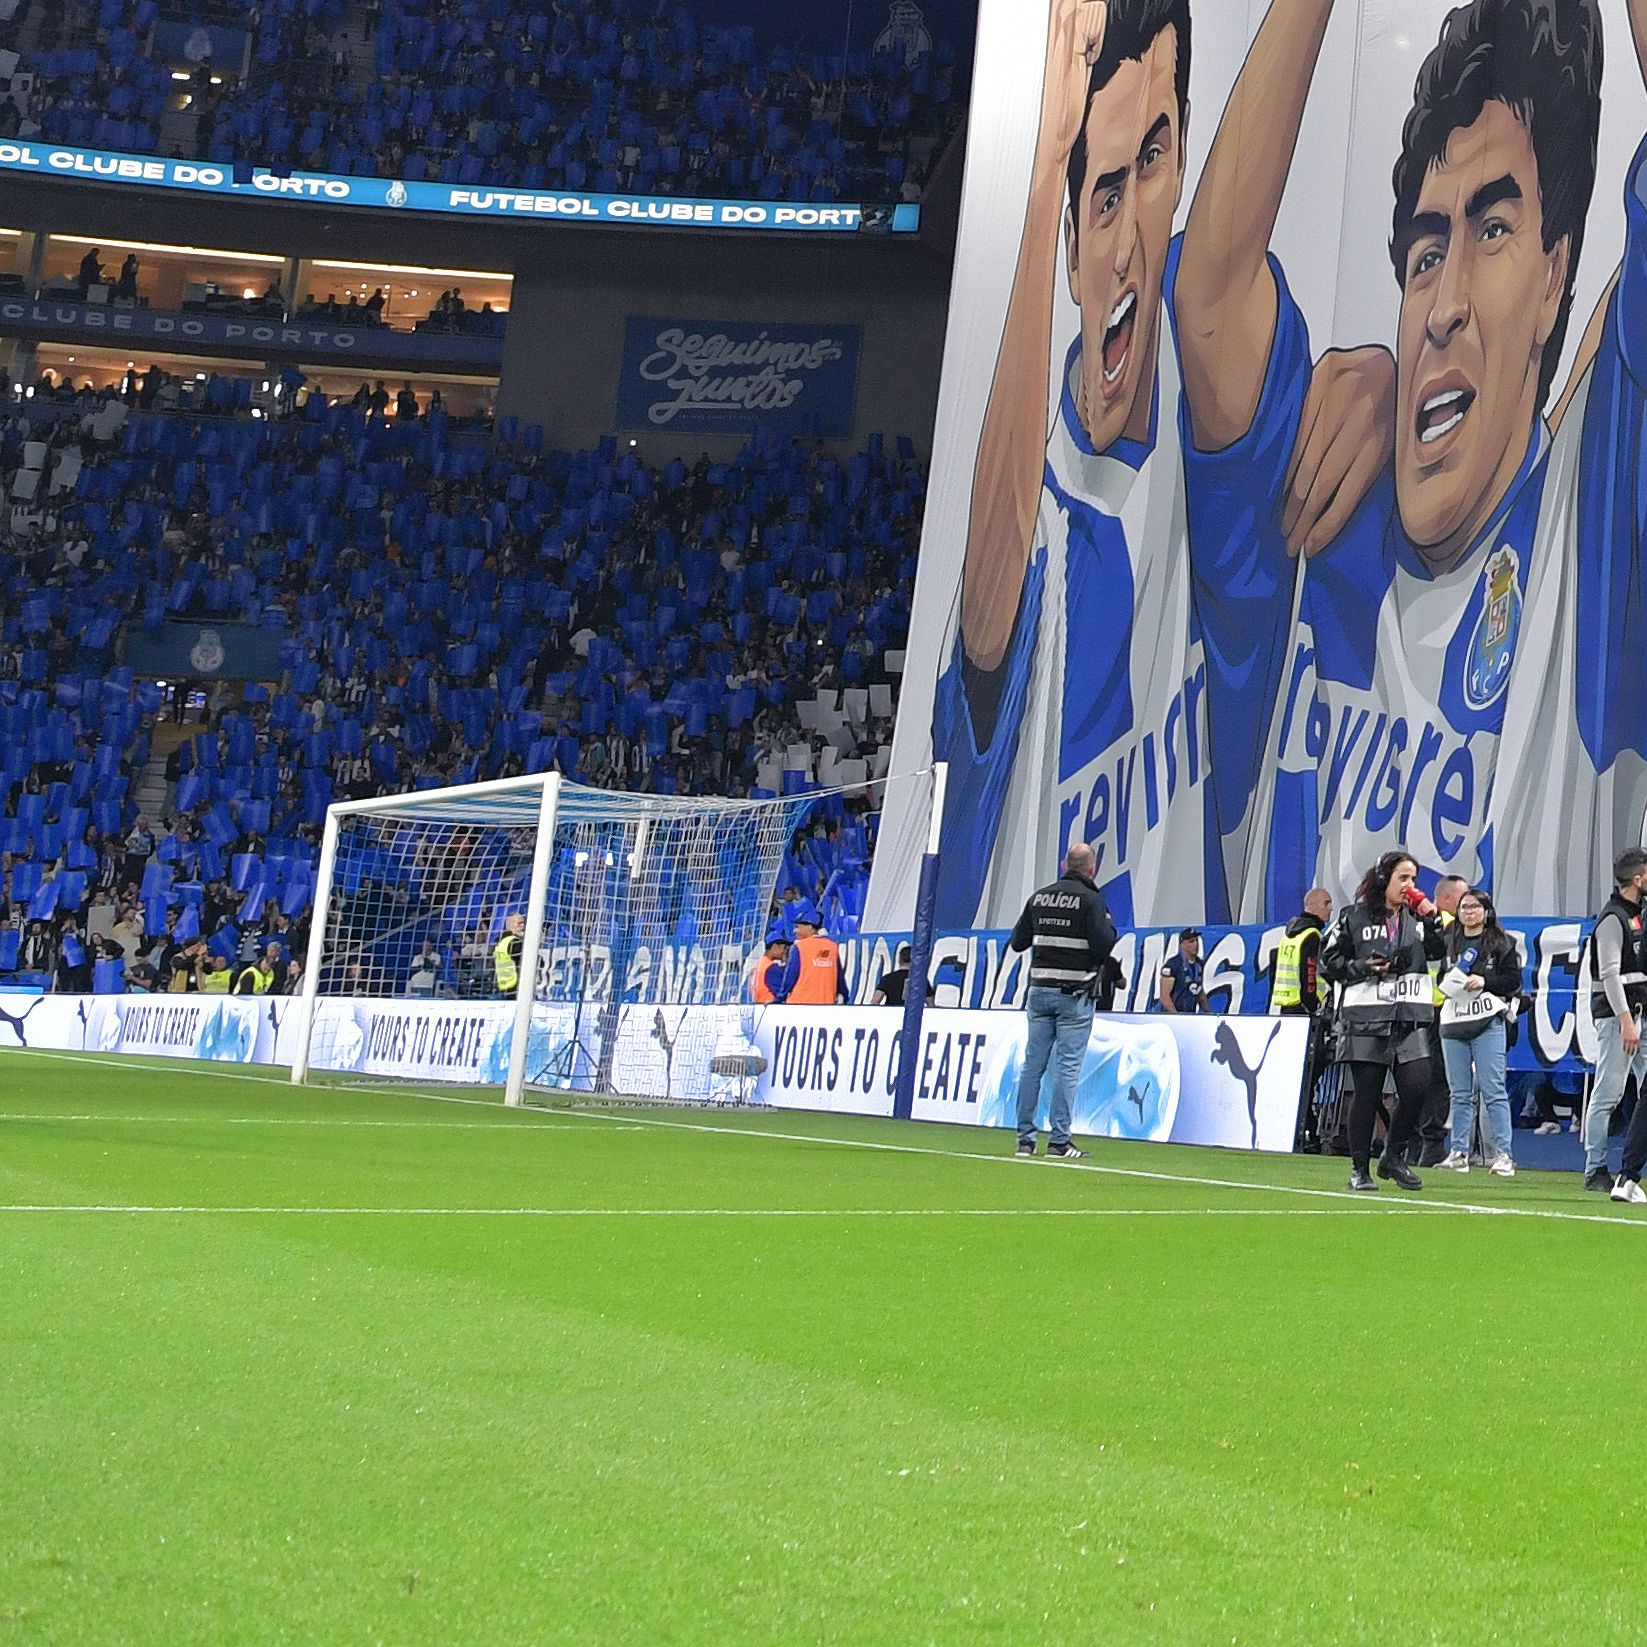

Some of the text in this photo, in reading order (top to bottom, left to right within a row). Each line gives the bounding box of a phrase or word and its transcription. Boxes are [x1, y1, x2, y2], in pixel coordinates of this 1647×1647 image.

[48, 151, 164, 180] CLUBE
[173, 164, 224, 187] DO
[232, 174, 350, 198] ORTO
[449, 190, 863, 227] FUTEBOL CLUBE DO PORT
[2, 305, 356, 348] CLUBE DO PORTO
[1033, 892, 1081, 910] POLÍCIA
[366, 1013, 485, 1067] YOURS TO CREATE
[771, 1025, 987, 1104] YOURS TO CEATE
